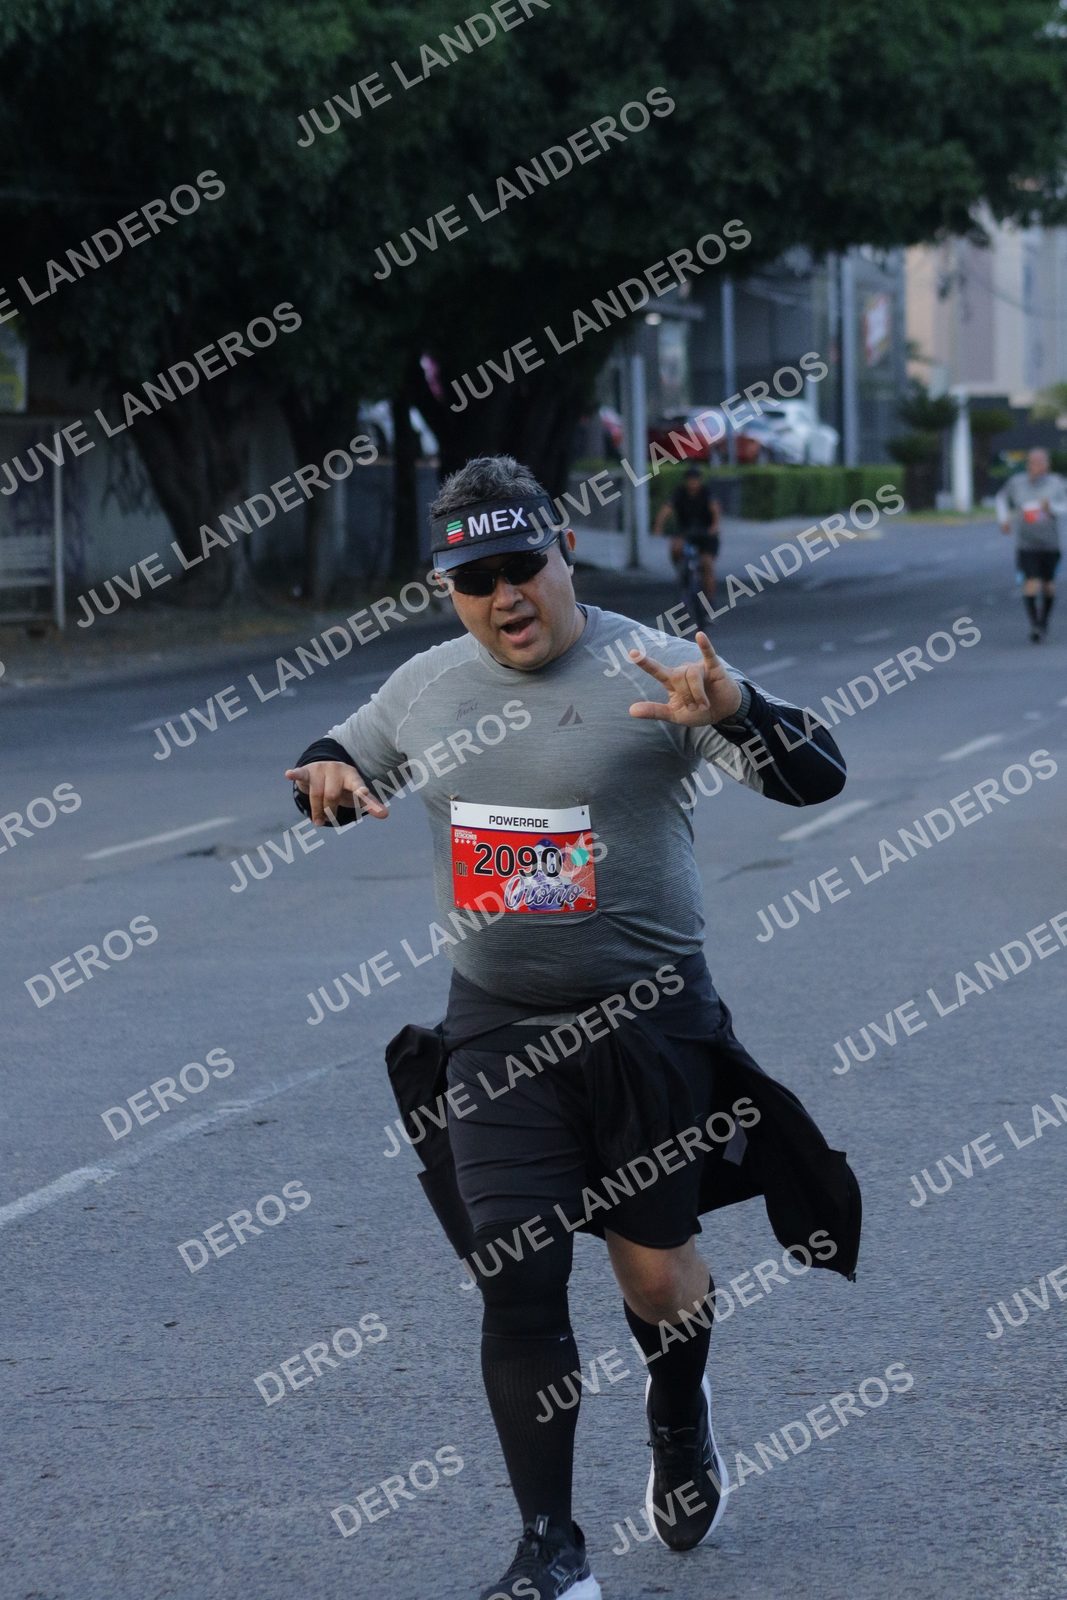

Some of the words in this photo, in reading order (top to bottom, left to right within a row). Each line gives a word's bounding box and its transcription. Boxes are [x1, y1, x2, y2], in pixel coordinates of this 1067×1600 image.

[467, 507, 528, 537] MEX
[489, 815, 549, 828] POWERADE
[474, 842, 563, 877] 2090
